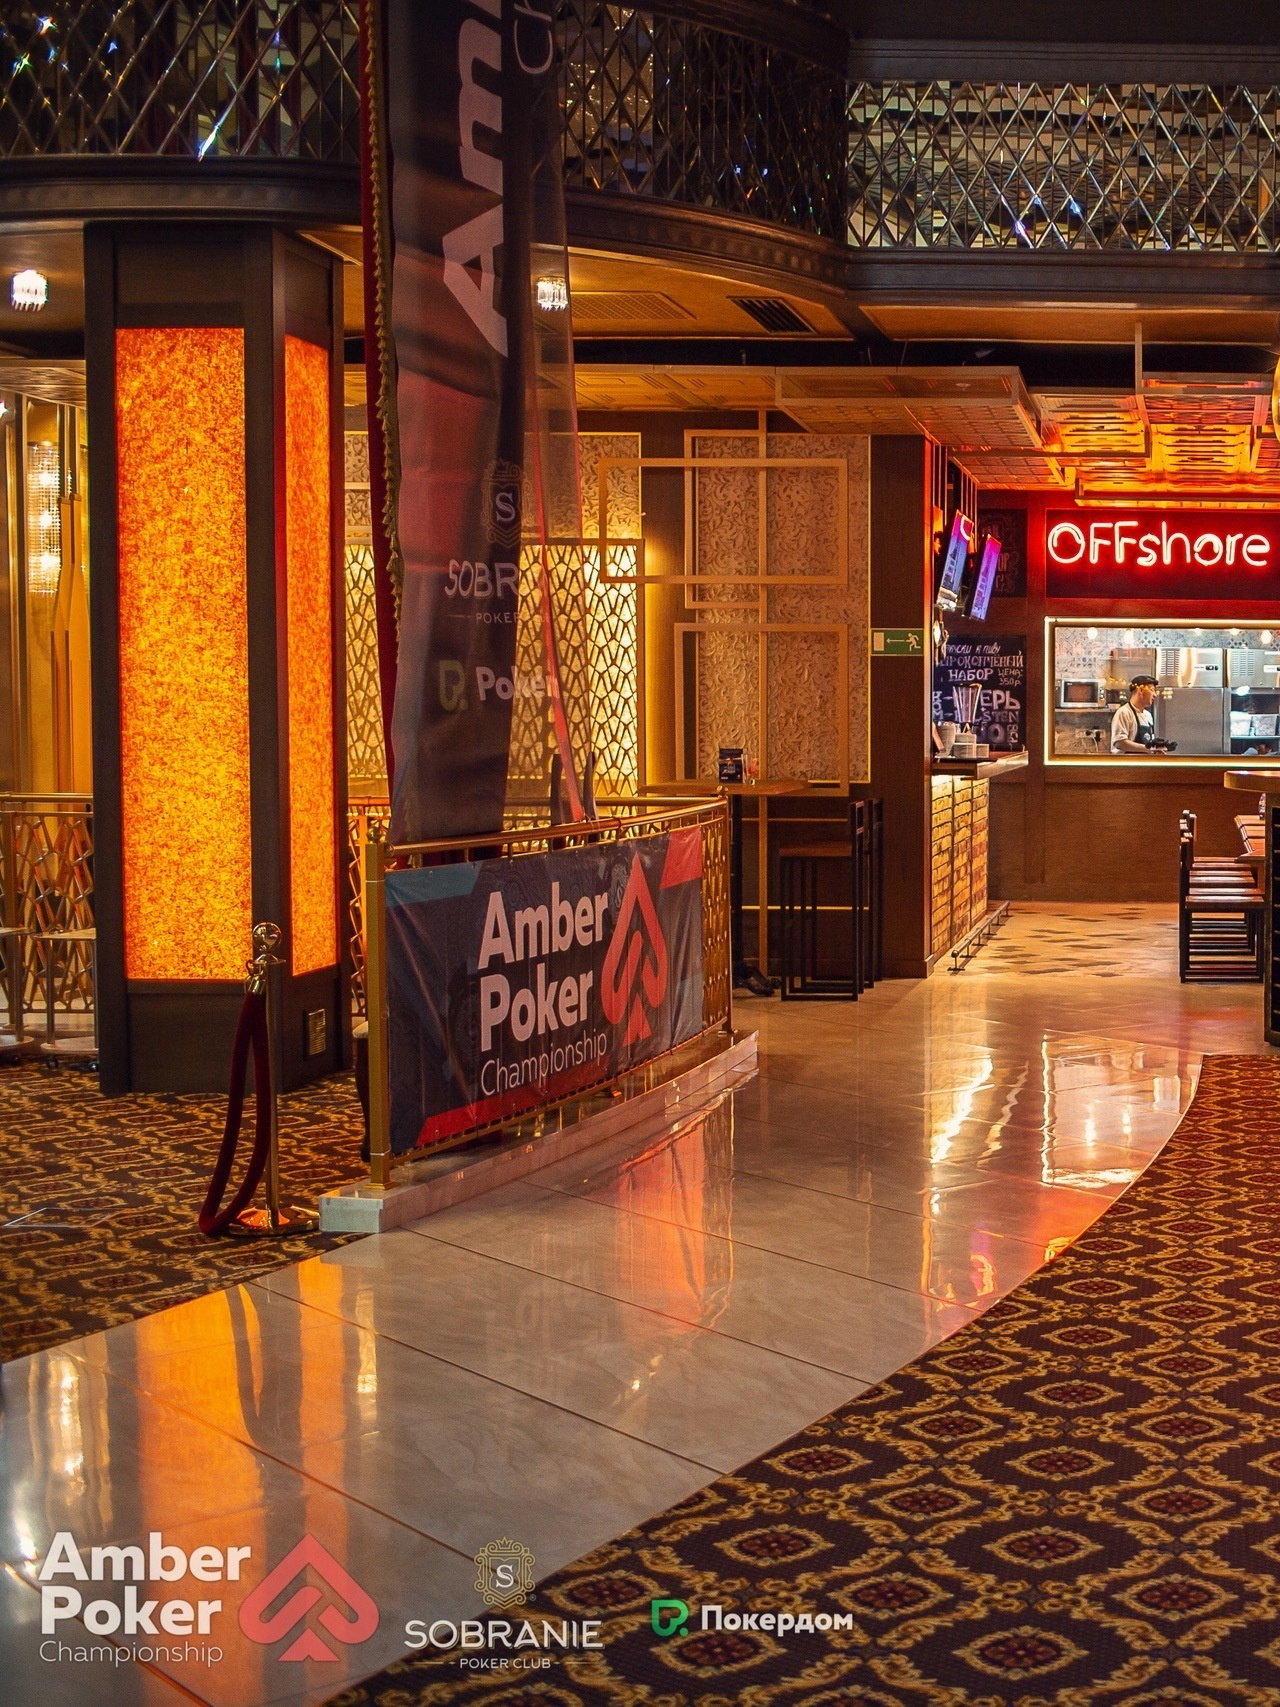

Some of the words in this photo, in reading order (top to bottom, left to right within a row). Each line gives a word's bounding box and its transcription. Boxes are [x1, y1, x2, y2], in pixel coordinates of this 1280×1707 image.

[477, 881, 609, 970] Amber
[479, 963, 594, 1053] Poker
[480, 1030, 608, 1097] Championship
